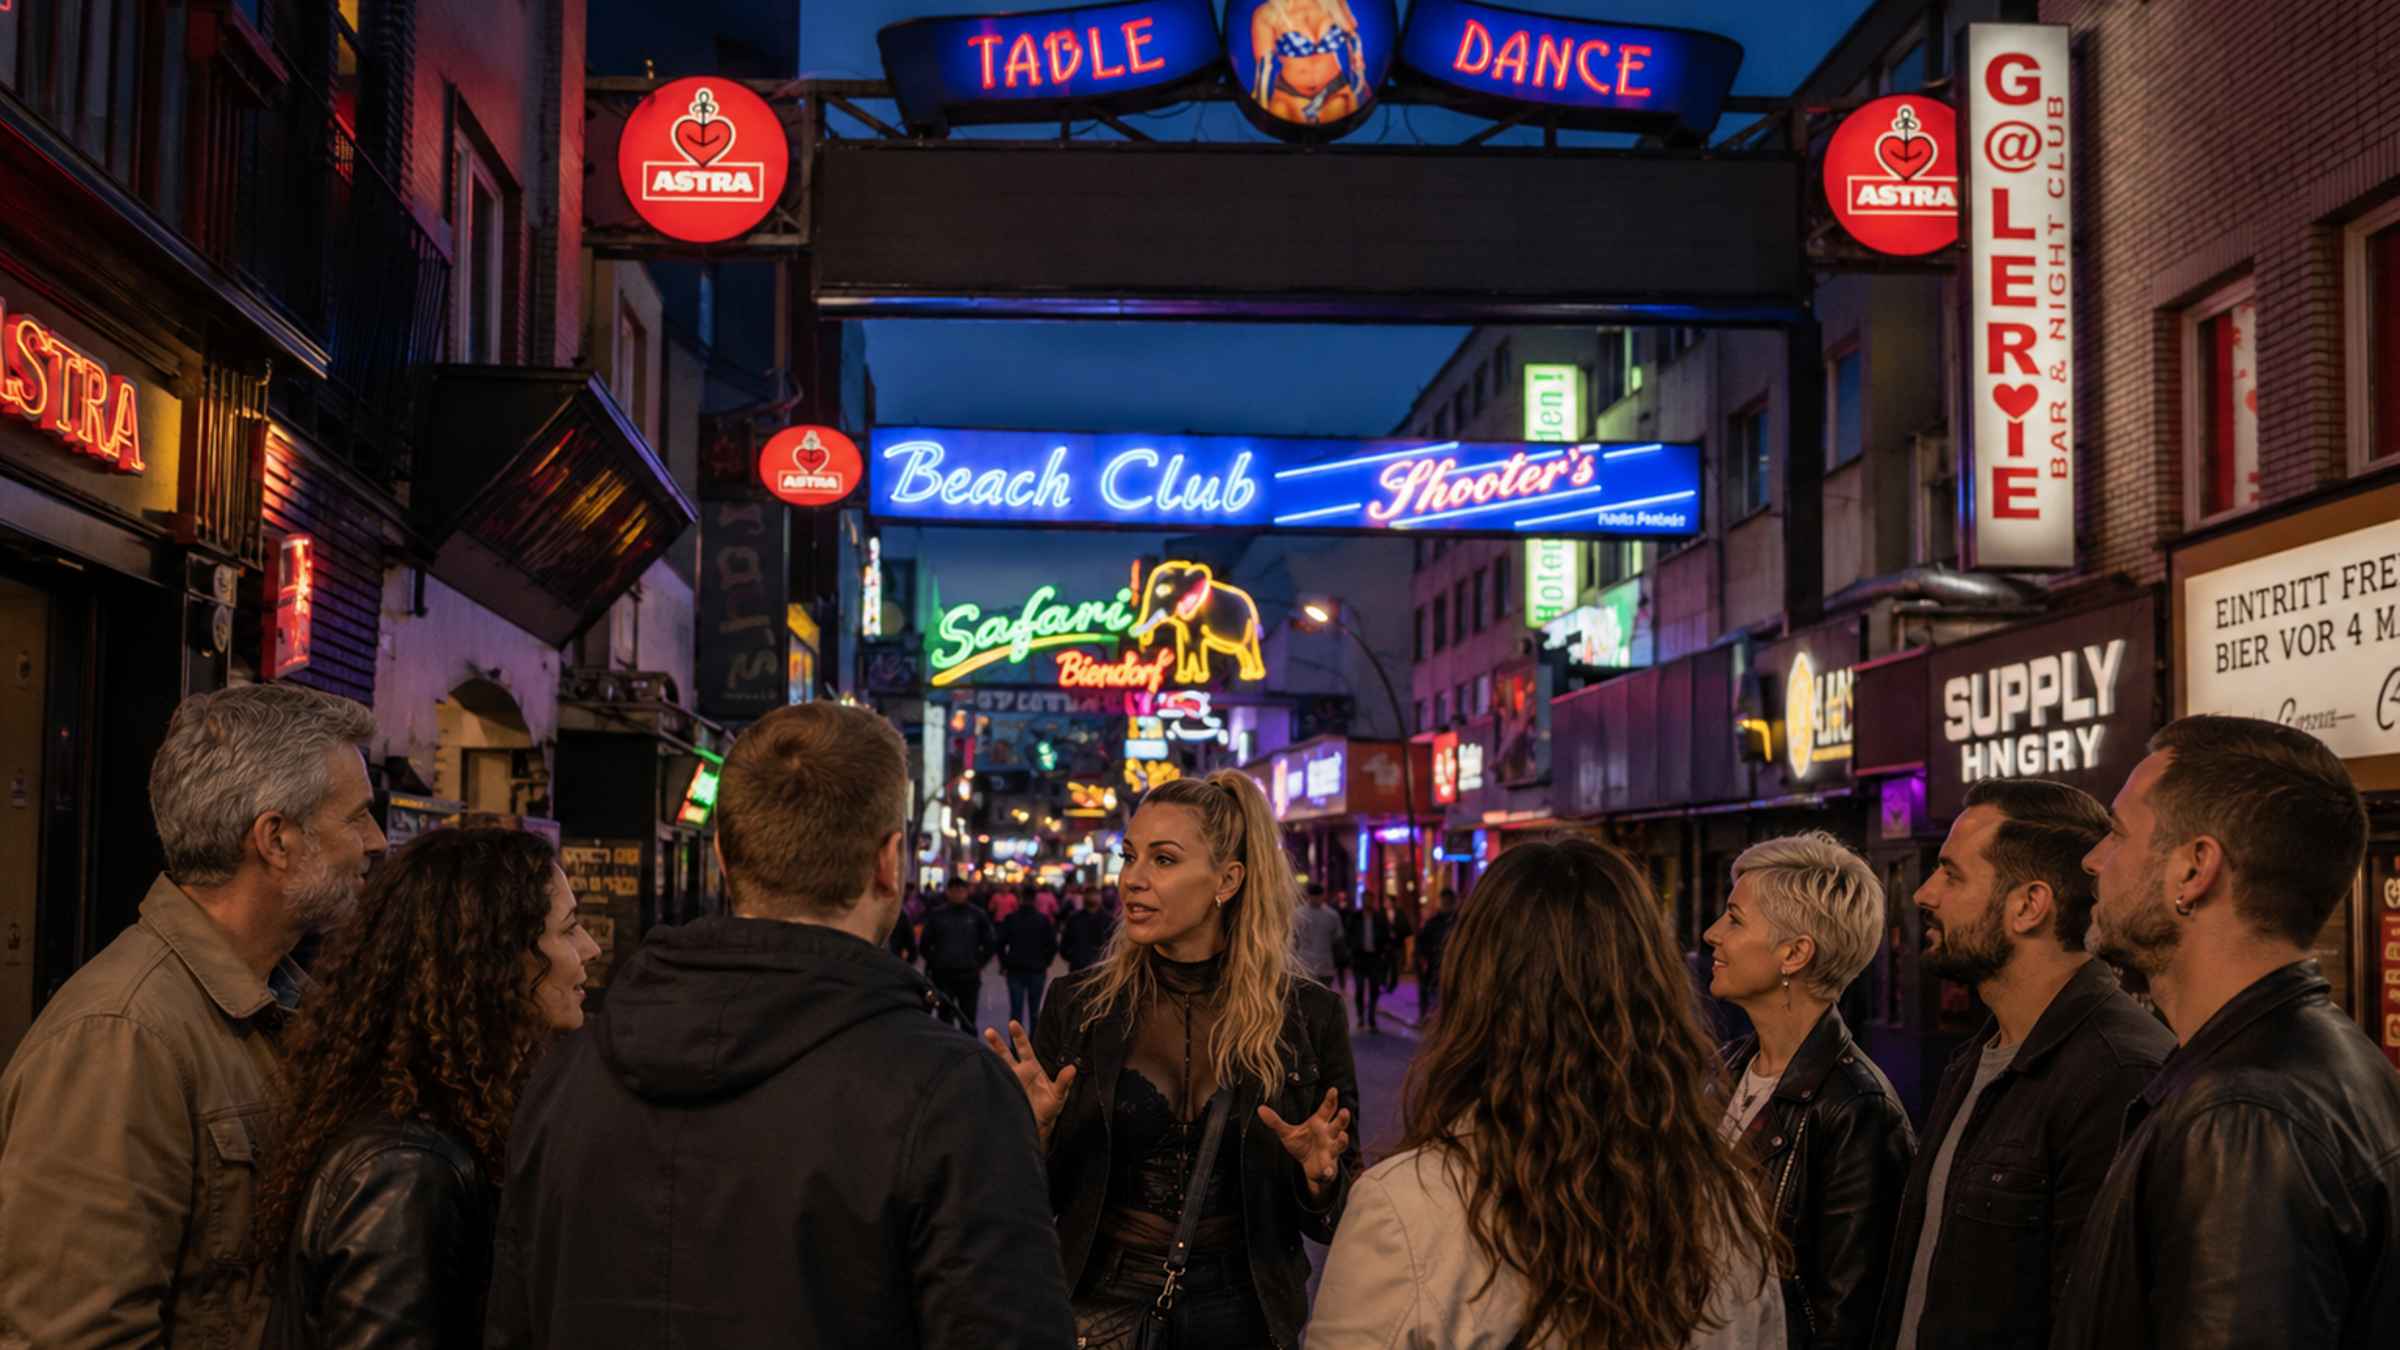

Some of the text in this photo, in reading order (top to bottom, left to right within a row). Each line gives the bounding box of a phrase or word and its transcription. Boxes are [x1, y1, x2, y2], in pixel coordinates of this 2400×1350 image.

[966, 17, 1653, 97] TABLE DANCE
[652, 170, 754, 192] ASTRA
[1855, 184, 1958, 207] ASTRA
[2047, 96, 2068, 479] BAR & NIGHT CLUB
[883, 440, 1256, 513] Beach Club
[1367, 447, 1597, 520] Shooter's
[930, 584, 1134, 669] Safari
[2215, 553, 2400, 630] EINTRITT FRE
[2215, 603, 2400, 675] BIER VOR 4 M
[1943, 637, 2128, 743] SUPPLY
[1961, 722, 2107, 784] HNGRY
